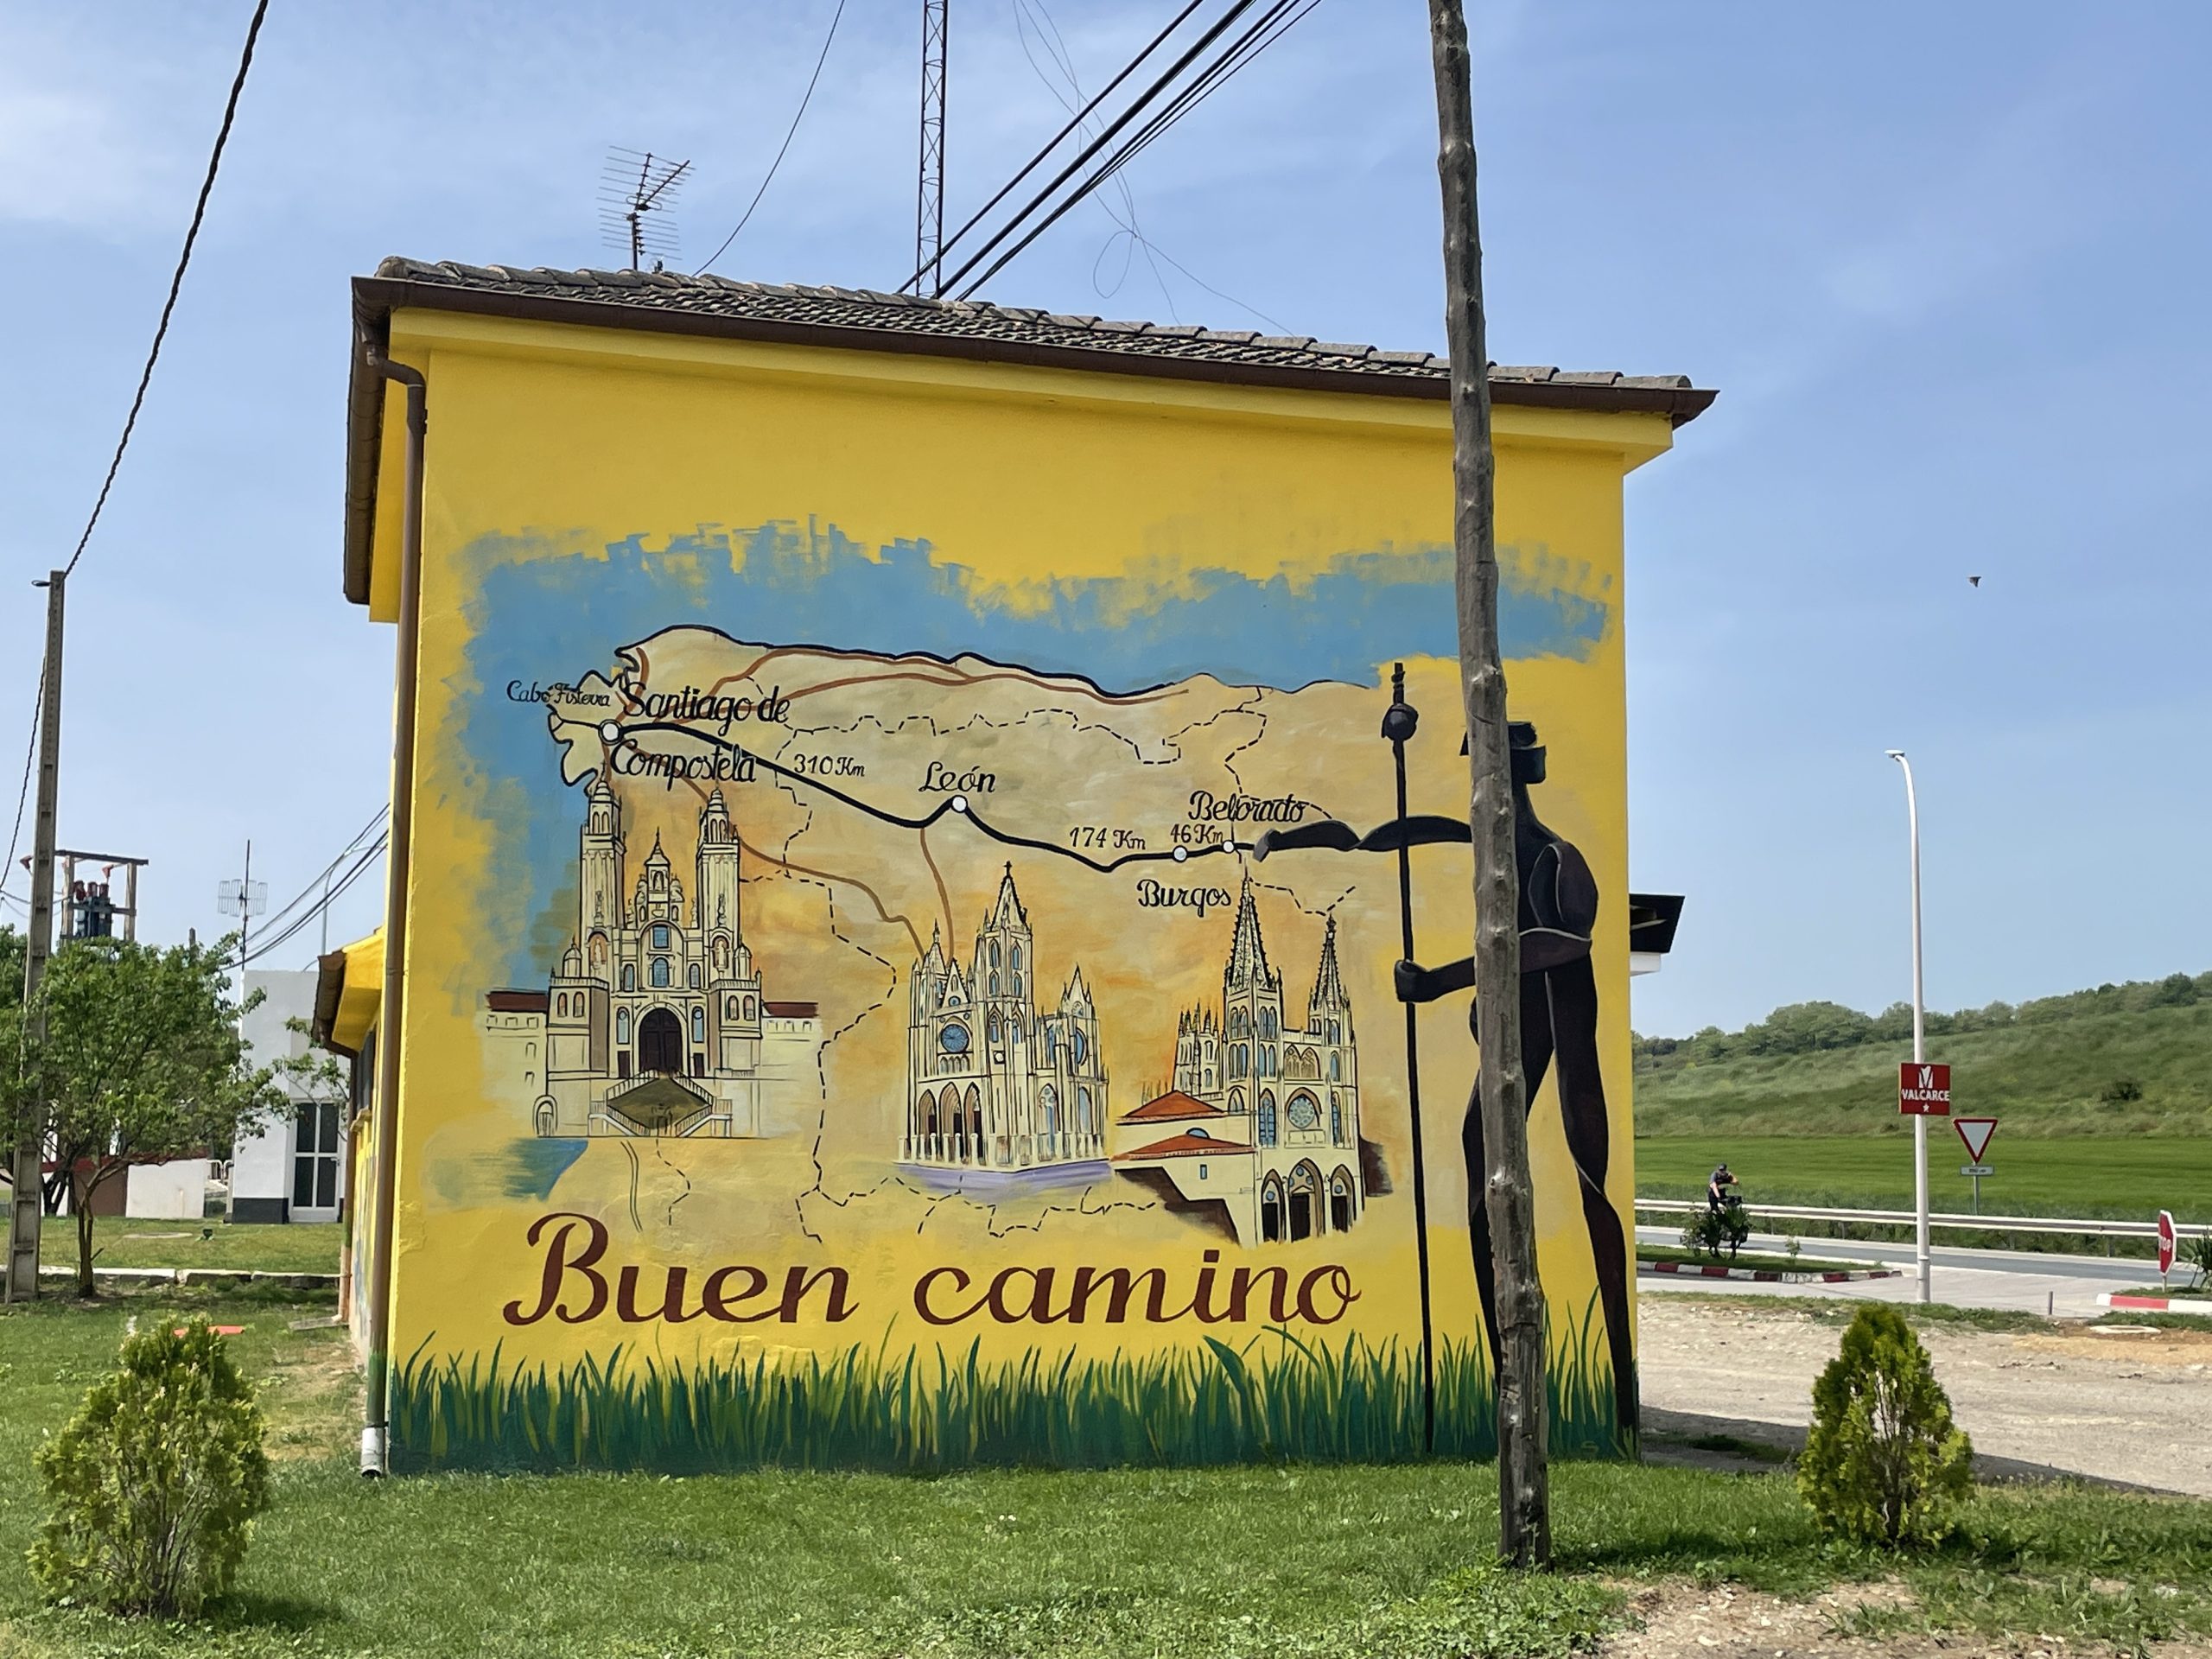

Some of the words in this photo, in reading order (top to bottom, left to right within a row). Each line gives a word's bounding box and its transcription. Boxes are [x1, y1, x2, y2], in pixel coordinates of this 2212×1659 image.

[506, 680, 551, 702] Cabo
[622, 682, 754, 736] Santiago
[758, 686, 791, 724] de
[609, 741, 757, 792] Compostela
[793, 753, 833, 776] 310
[835, 754, 865, 778] Km
[918, 761, 996, 793] León
[1188, 790, 1306, 822] Belorado
[1069, 827, 1107, 849] 174
[1114, 830, 1146, 850] Km
[1170, 823, 1192, 843] 46
[1193, 823, 1224, 844] Km
[1137, 878, 1232, 918] Burgos
[1901, 1089, 1950, 1102] VALCARCE
[504, 1212, 858, 1325] Buen
[914, 1249, 1362, 1325] camino
